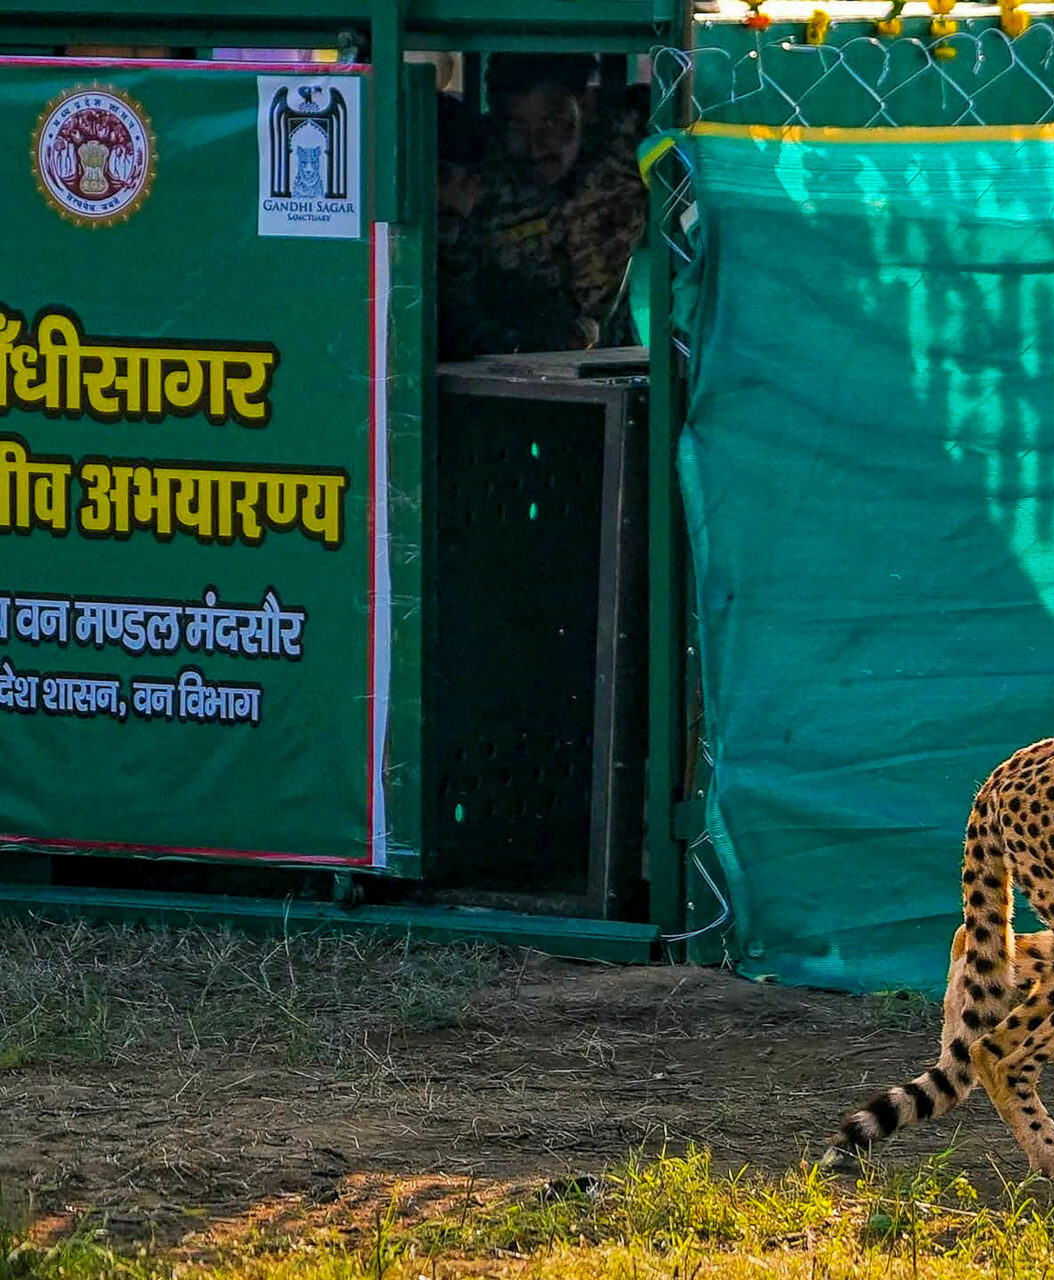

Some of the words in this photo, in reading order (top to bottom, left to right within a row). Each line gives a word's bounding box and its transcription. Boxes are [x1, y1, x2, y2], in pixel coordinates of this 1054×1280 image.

[262, 199, 313, 212] GANDHI
[316, 200, 355, 213] SAGAR
[80, 464, 345, 542] अभयारण्य
[15, 598, 70, 641] वन
[74, 601, 183, 650] मण्डल
[184, 591, 305, 655] मंदसौर
[42, 678, 127, 716] शासन,
[133, 682, 175, 716] वन
[178, 671, 260, 721] विभाग
